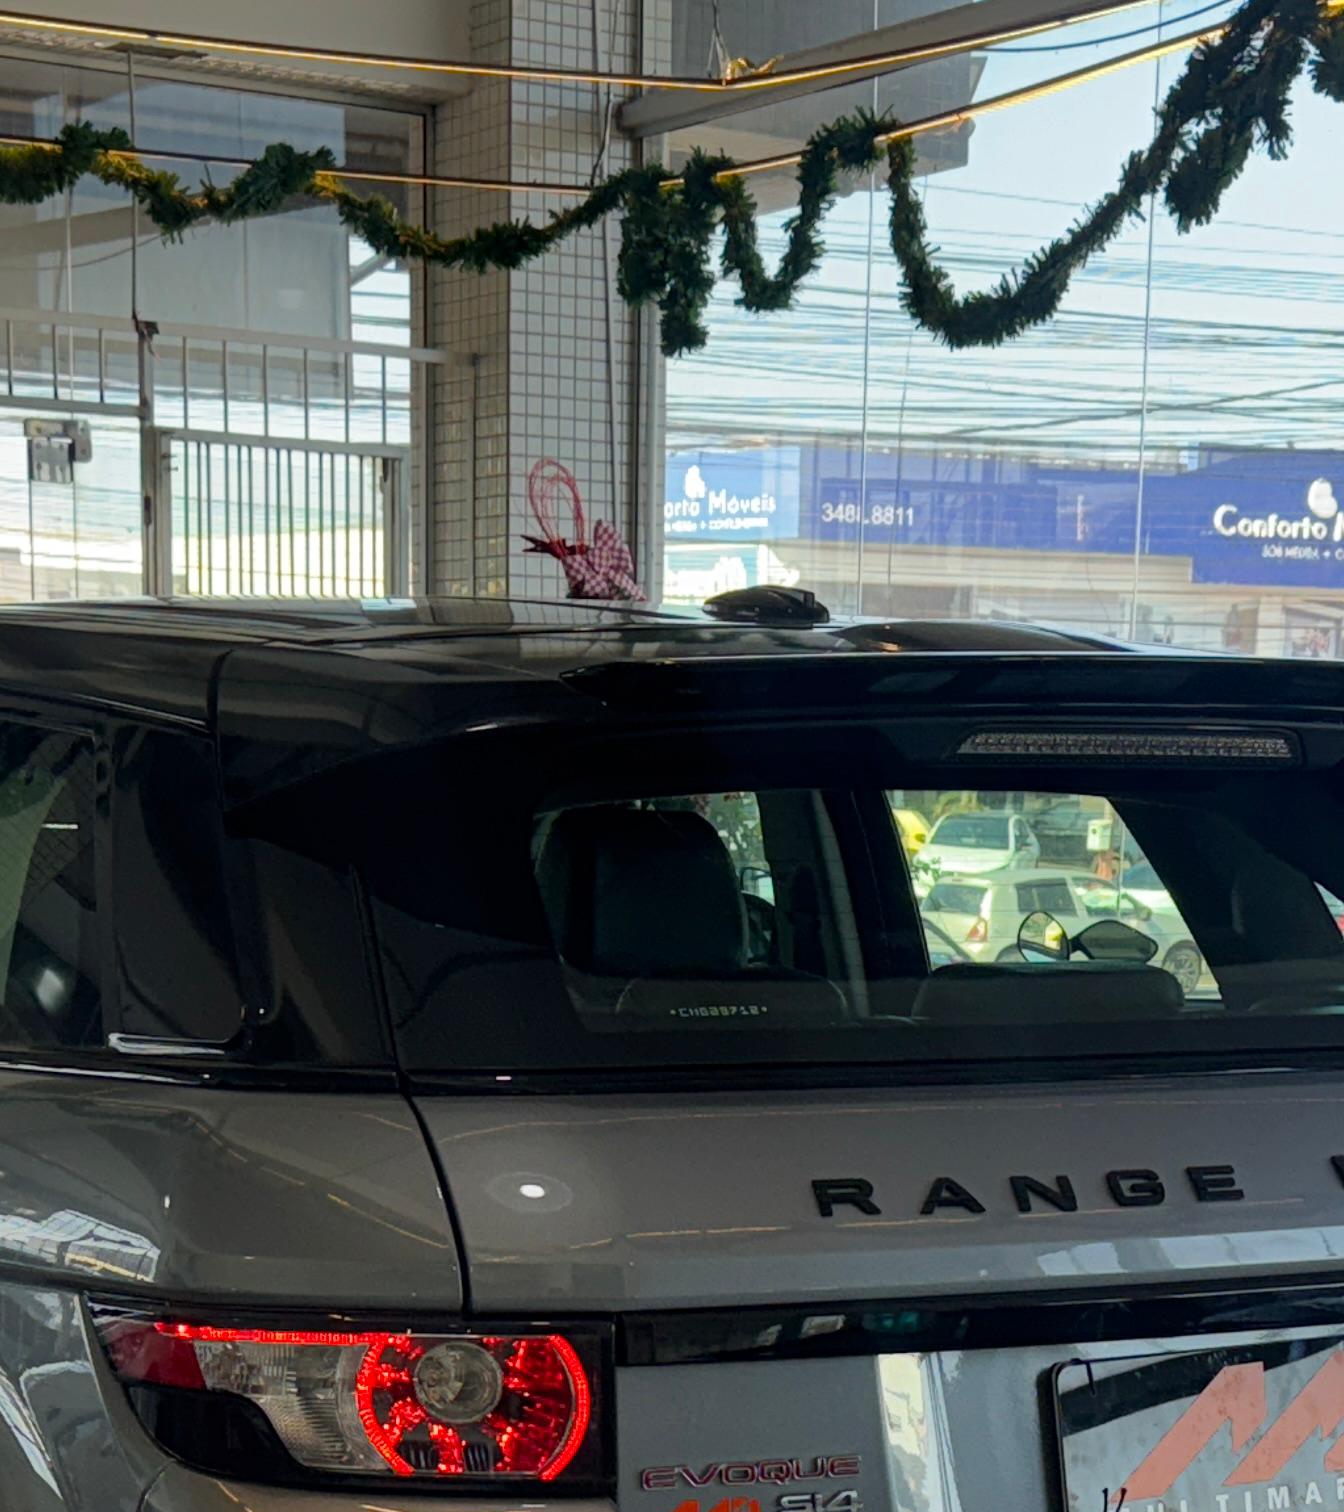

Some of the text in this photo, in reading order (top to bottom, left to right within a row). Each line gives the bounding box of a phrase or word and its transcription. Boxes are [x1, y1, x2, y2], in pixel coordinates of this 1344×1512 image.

[664, 489, 776, 519] orto Móveis
[1213, 504, 1327, 540] Conforto
[811, 1165, 1244, 1217] RANGE
[642, 1454, 862, 1490] EVOQUE
